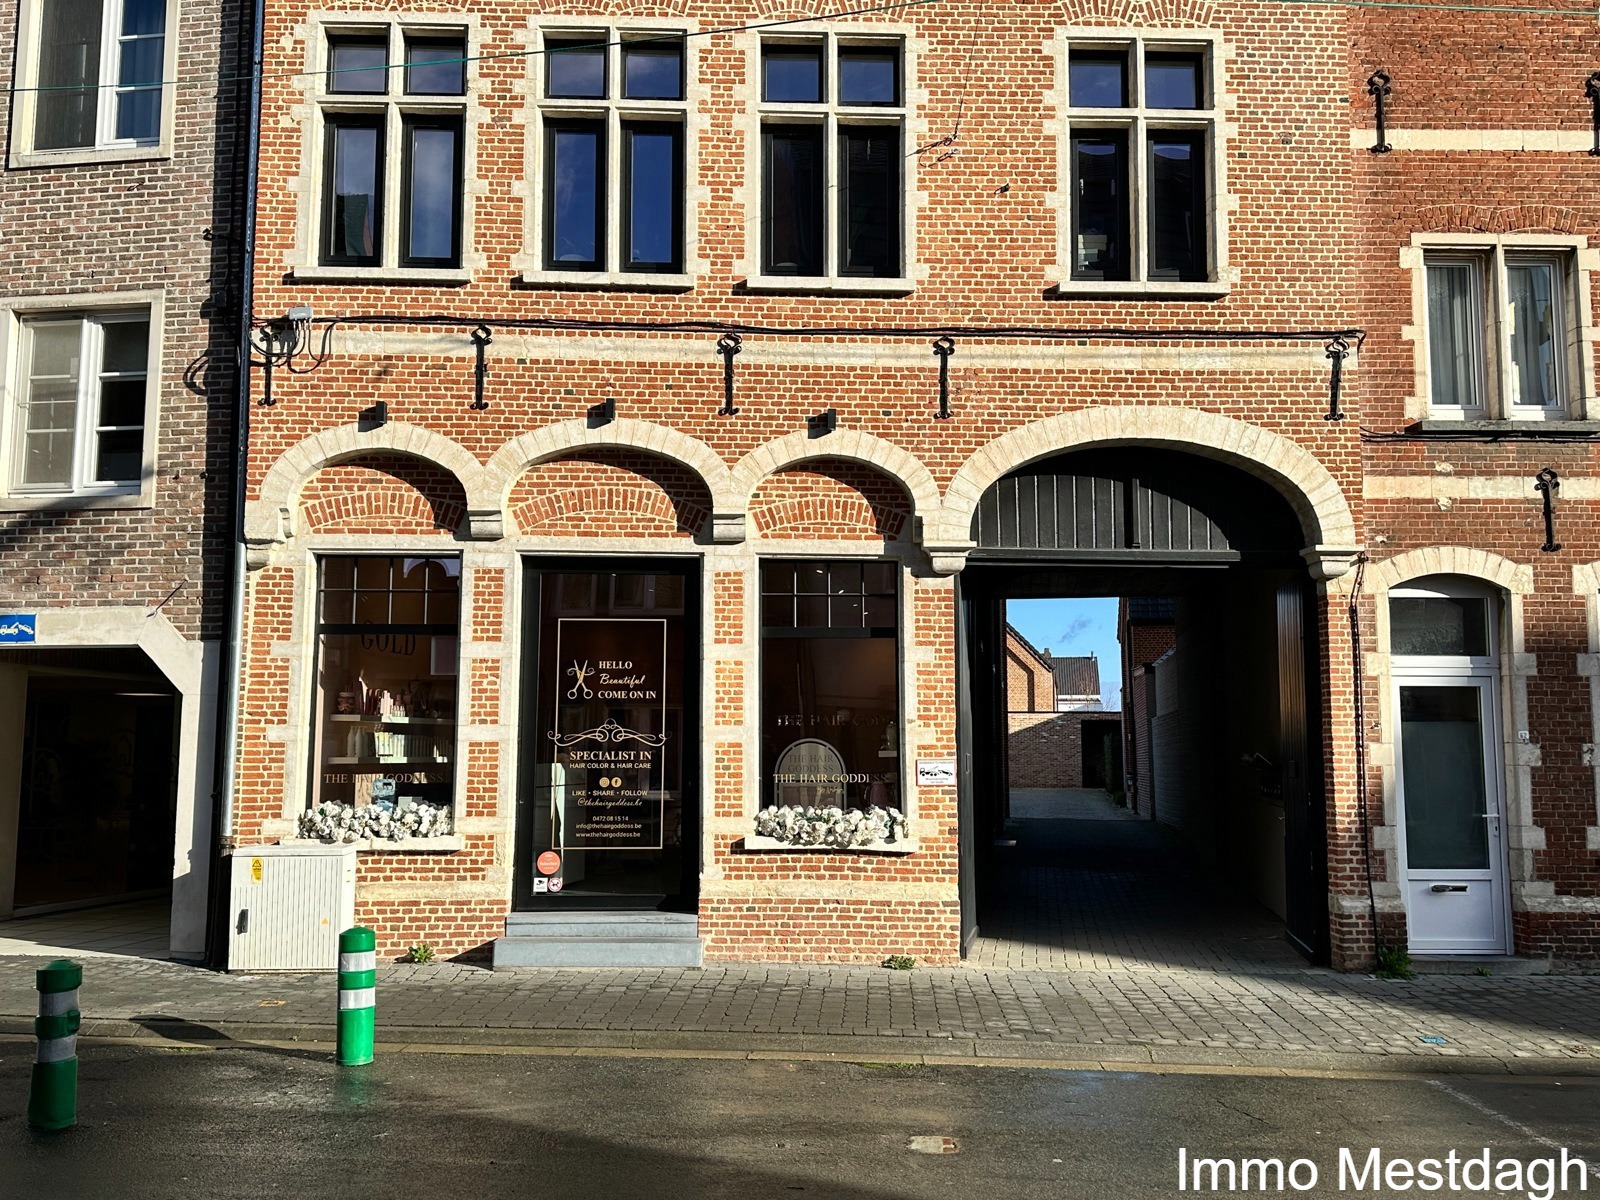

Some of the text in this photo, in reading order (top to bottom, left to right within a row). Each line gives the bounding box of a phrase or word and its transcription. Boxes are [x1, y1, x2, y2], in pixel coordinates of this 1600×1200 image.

[599, 661, 633, 669] HELLO
[599, 673, 646, 688] Beautiful
[598, 690, 657, 699] COME ON IN
[569, 751, 652, 761] SPECIALIST IN
[788, 755, 834, 763] THE HAIR
[788, 765, 834, 773] GODDESS
[323, 773, 348, 784] THE
[386, 772, 444, 784] GODDESS
[773, 773, 887, 784] THE HAIR GODDESS
